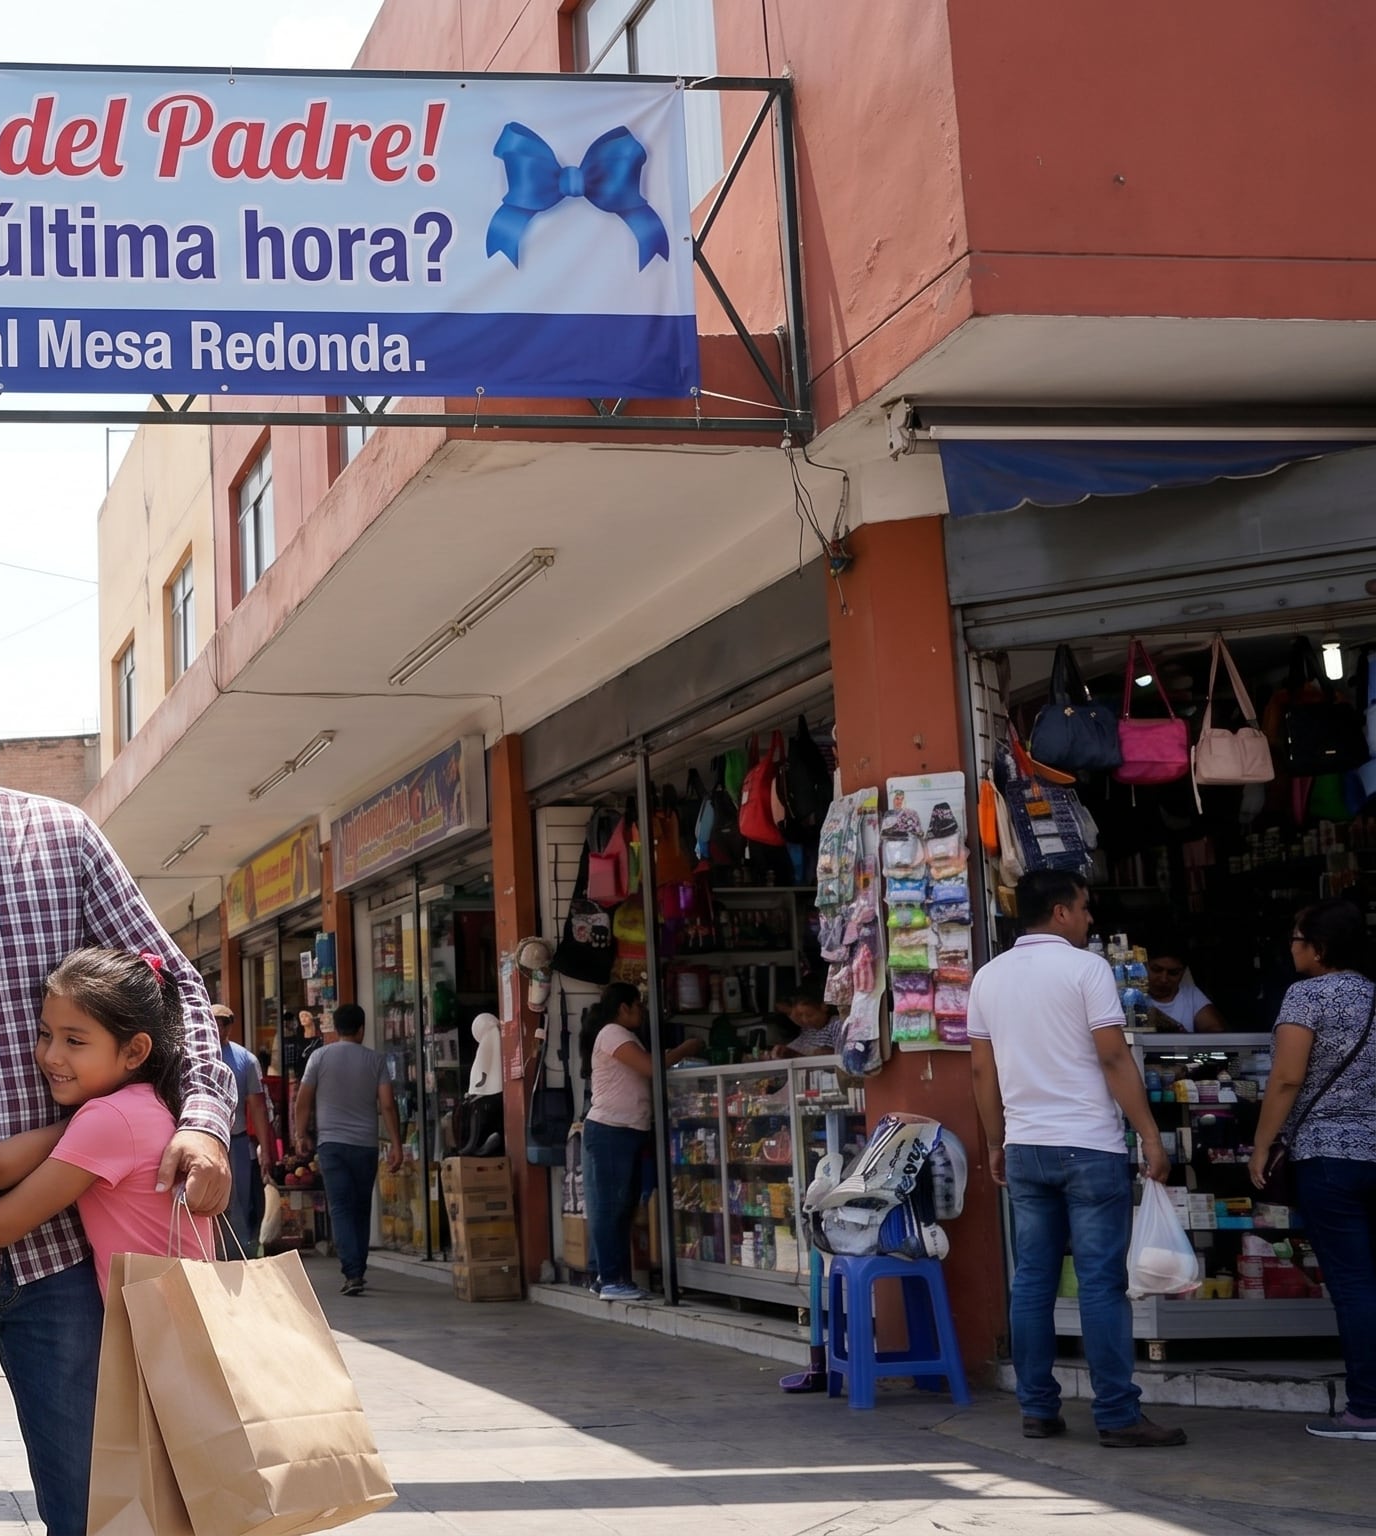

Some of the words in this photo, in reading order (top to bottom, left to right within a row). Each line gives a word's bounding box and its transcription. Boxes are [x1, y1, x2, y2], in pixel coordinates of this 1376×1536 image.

[147, 95, 445, 182] Padre!
[244, 209, 453, 283] hora?
[38, 319, 172, 370] Mesa
[191, 320, 426, 373] Redonda.
